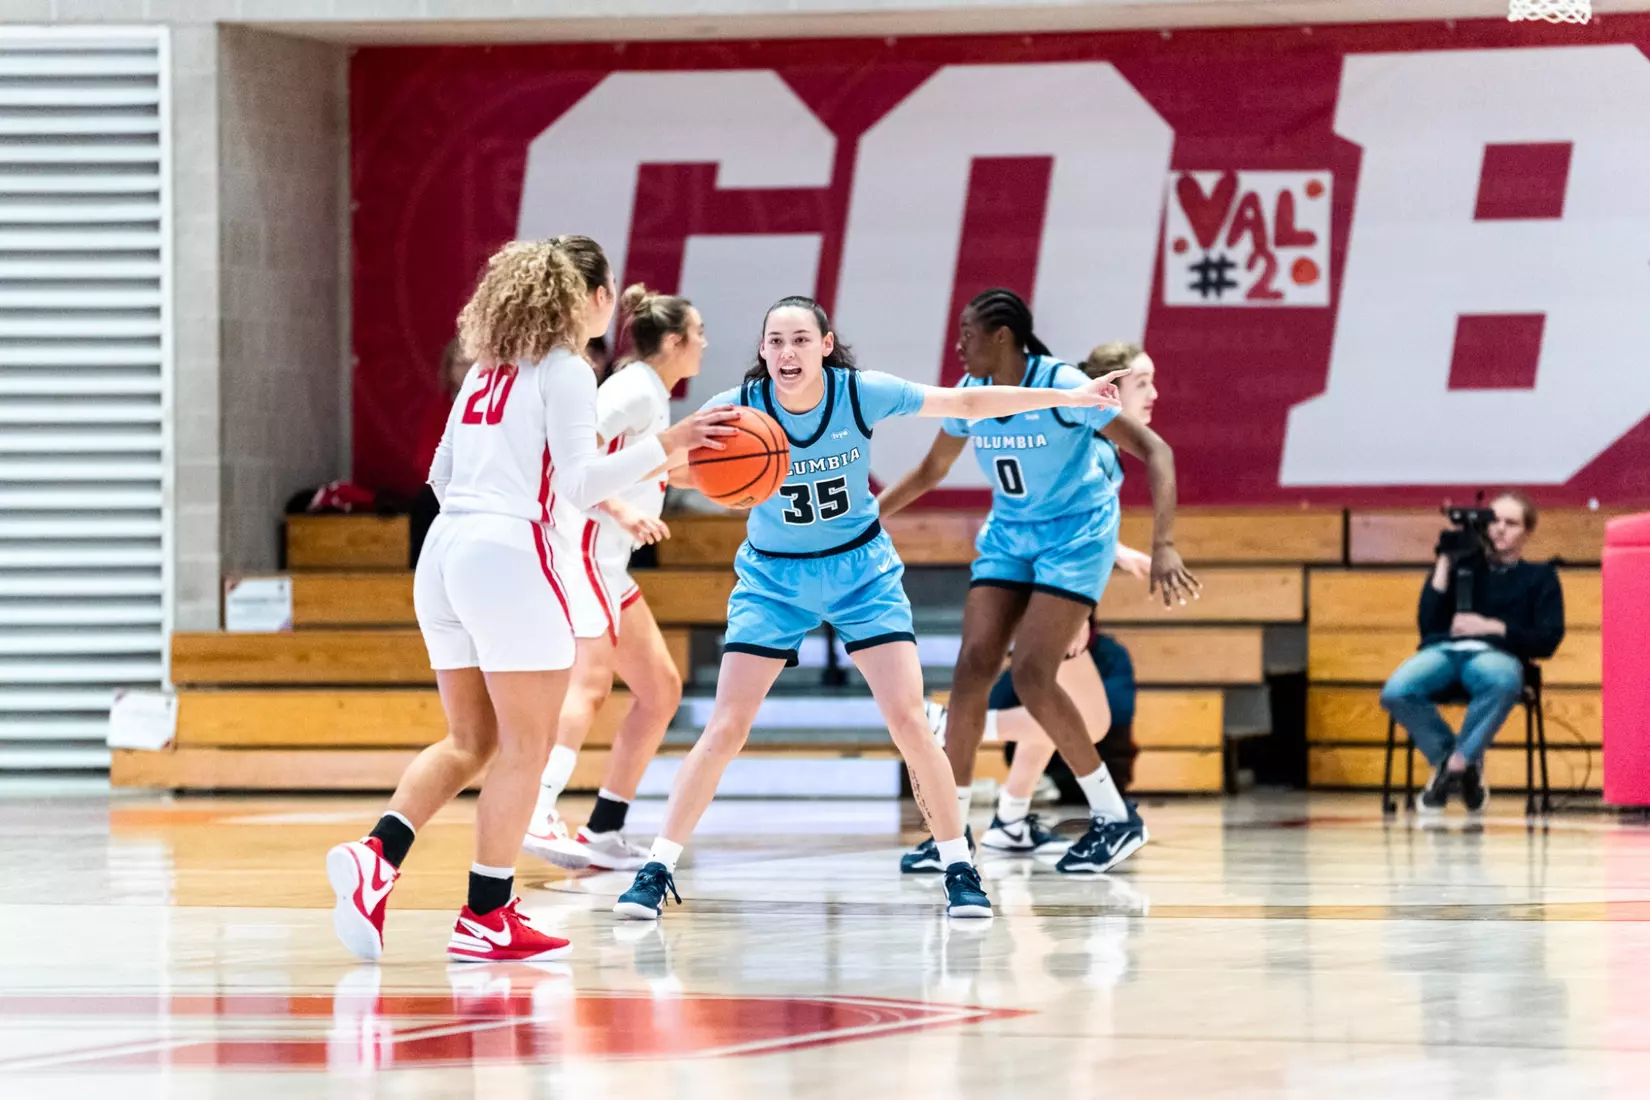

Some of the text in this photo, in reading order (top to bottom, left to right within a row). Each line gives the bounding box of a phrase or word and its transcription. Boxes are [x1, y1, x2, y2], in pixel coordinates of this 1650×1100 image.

[1176, 170, 1317, 249] VAL
[1188, 248, 1285, 300] #2
[462, 363, 519, 426] 20
[778, 474, 851, 526] 35
[993, 455, 1027, 499] 0
